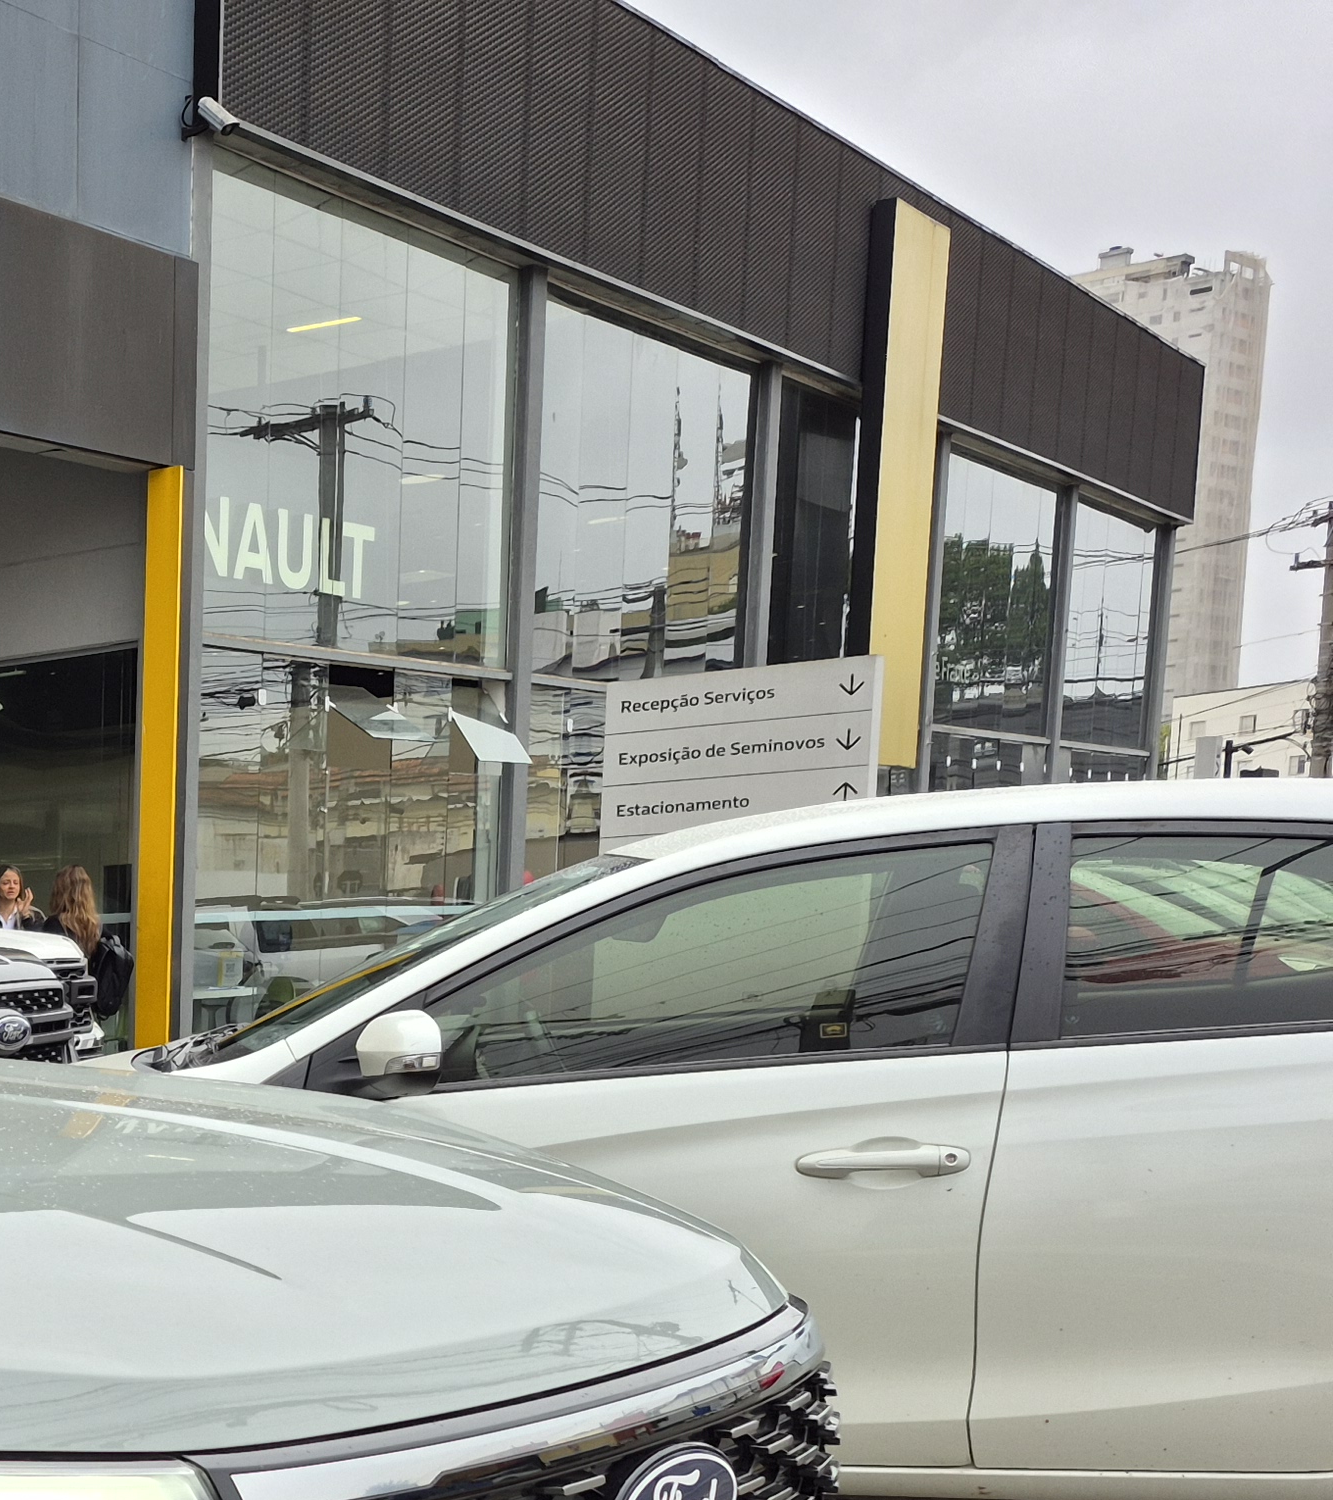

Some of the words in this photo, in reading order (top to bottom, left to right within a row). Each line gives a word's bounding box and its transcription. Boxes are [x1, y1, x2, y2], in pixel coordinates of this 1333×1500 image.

[620, 693, 700, 714] Recepção
[703, 687, 776, 707] Serviços
[618, 746, 701, 767] Exposição
[705, 744, 726, 758] de
[729, 735, 826, 756] Seminovos
[616, 795, 750, 818] Estacionamento
